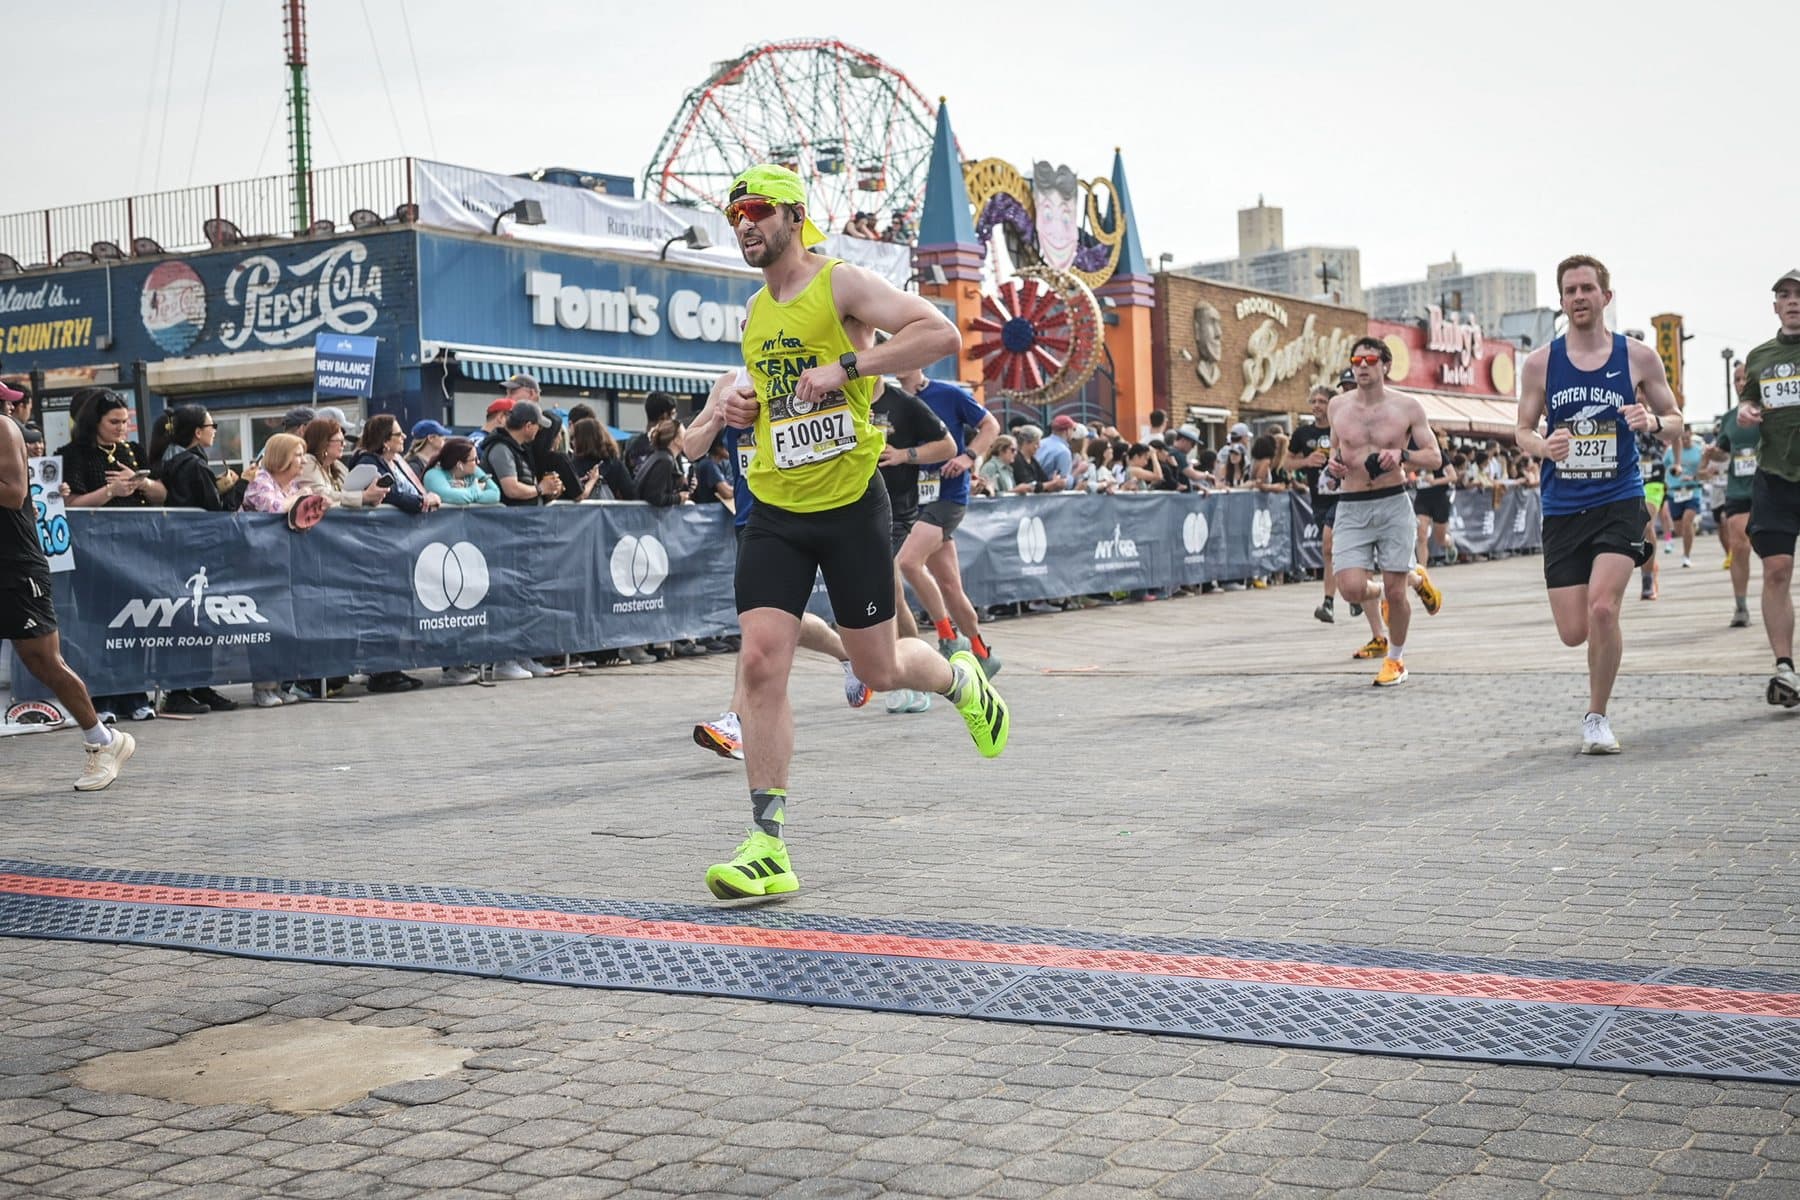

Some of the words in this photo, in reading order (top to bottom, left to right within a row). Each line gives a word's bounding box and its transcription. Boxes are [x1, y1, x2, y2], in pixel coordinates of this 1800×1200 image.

[608, 216, 629, 236] Run
[0, 280, 48, 313] sland
[525, 270, 660, 336] Tom's
[668, 289, 745, 343] Con
[1235, 297, 1288, 327] BROOKLYN
[6, 317, 93, 354] COUNTRY!
[317, 360, 335, 372] NEW
[335, 361, 371, 376] BALANCE
[755, 355, 818, 378] TEAM
[318, 375, 367, 391] HOSPITALITY
[1763, 386, 1770, 398] C
[1776, 381, 1800, 396] 943
[1551, 387, 1587, 410] STATEN
[1590, 387, 1624, 408] ISLAND
[775, 432, 785, 452] F
[787, 413, 844, 449] 10097
[1575, 440, 1607, 457] 3237
[741, 454, 748, 468] B
[612, 597, 664, 614] mastercard
[419, 611, 488, 631] mastercard
[106, 638, 136, 650] NEW
[140, 636, 174, 648] YORK
[177, 635, 214, 647] ROAD
[217, 632, 272, 646] RUNNERS
